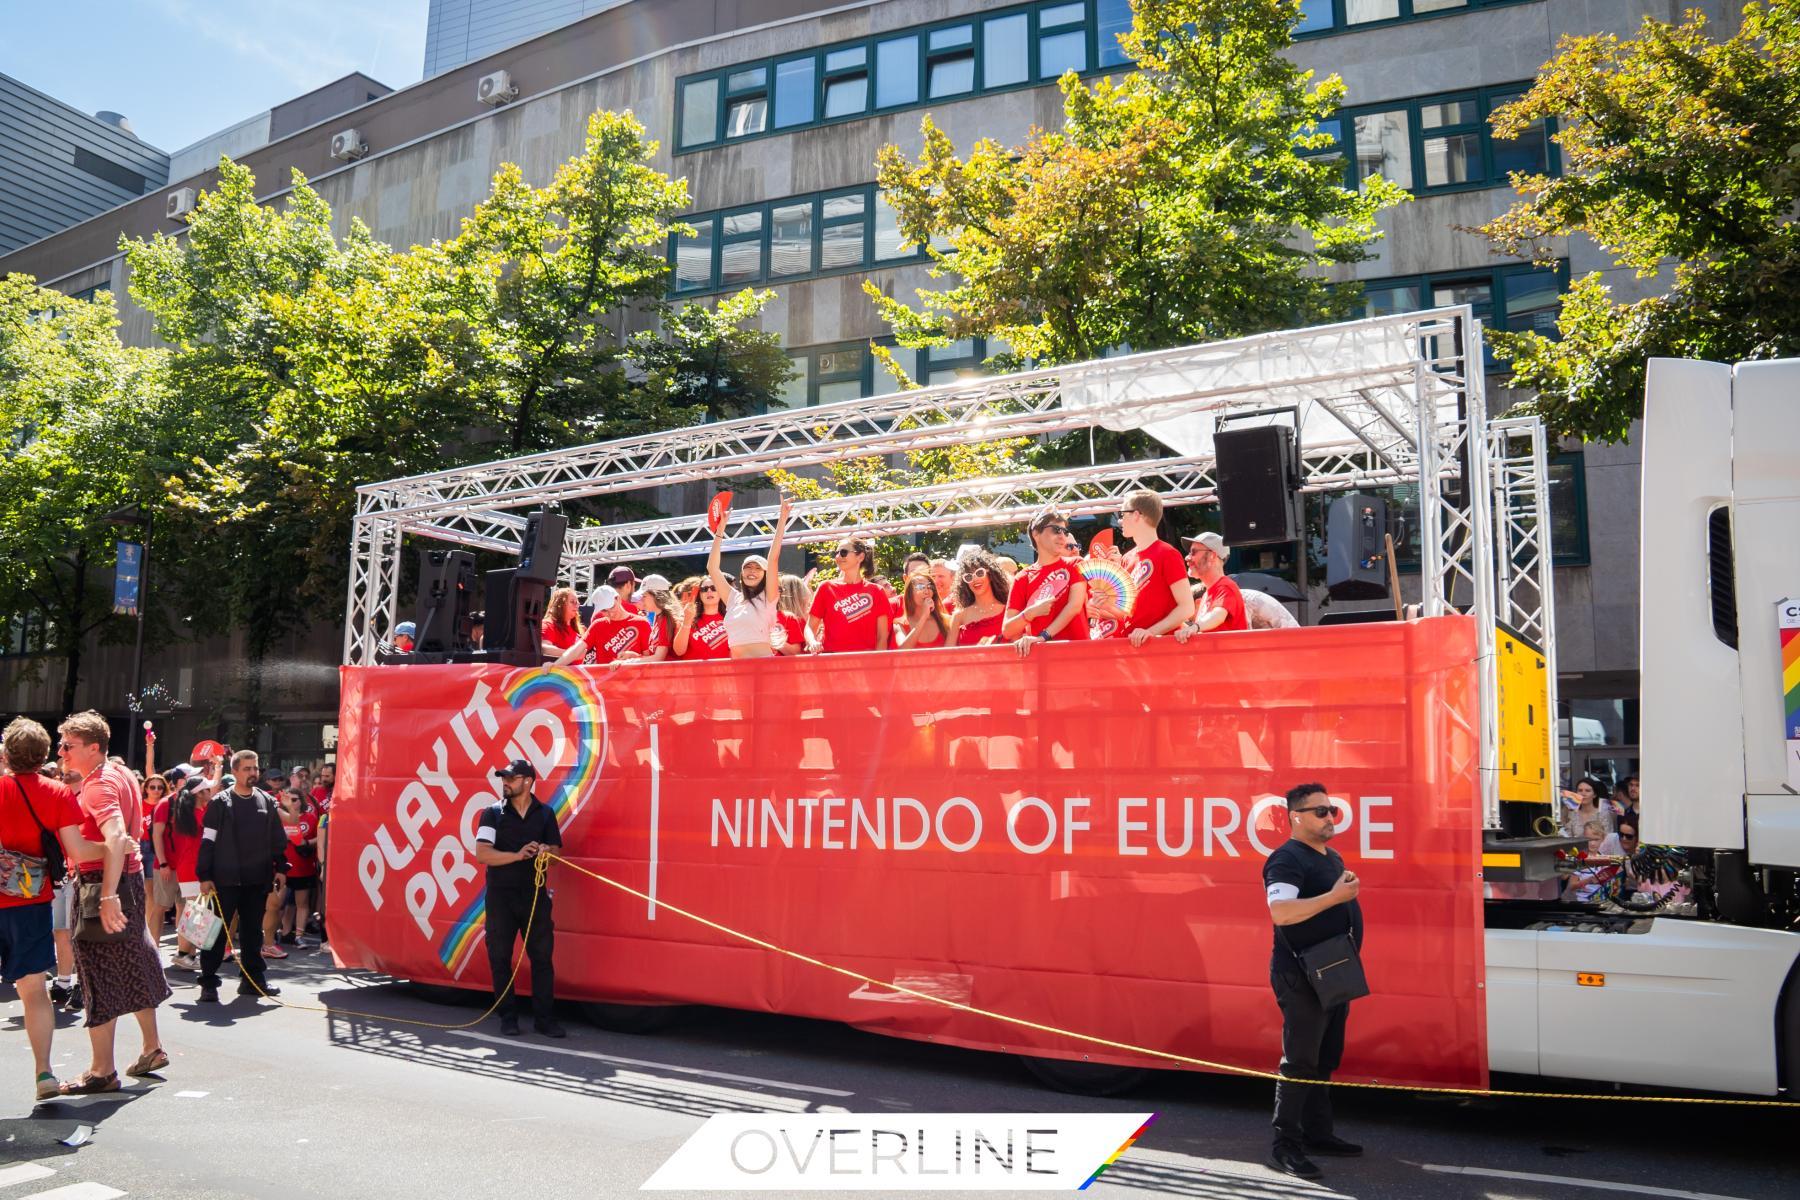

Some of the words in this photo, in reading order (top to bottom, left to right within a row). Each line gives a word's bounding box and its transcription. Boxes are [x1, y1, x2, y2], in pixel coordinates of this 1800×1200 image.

[841, 598, 869, 614] PROUD
[612, 630, 634, 653] PROUD
[358, 736, 460, 911] PLAY
[450, 680, 499, 766] IT
[711, 797, 983, 853] NINTENDO
[1006, 797, 1091, 854] OF
